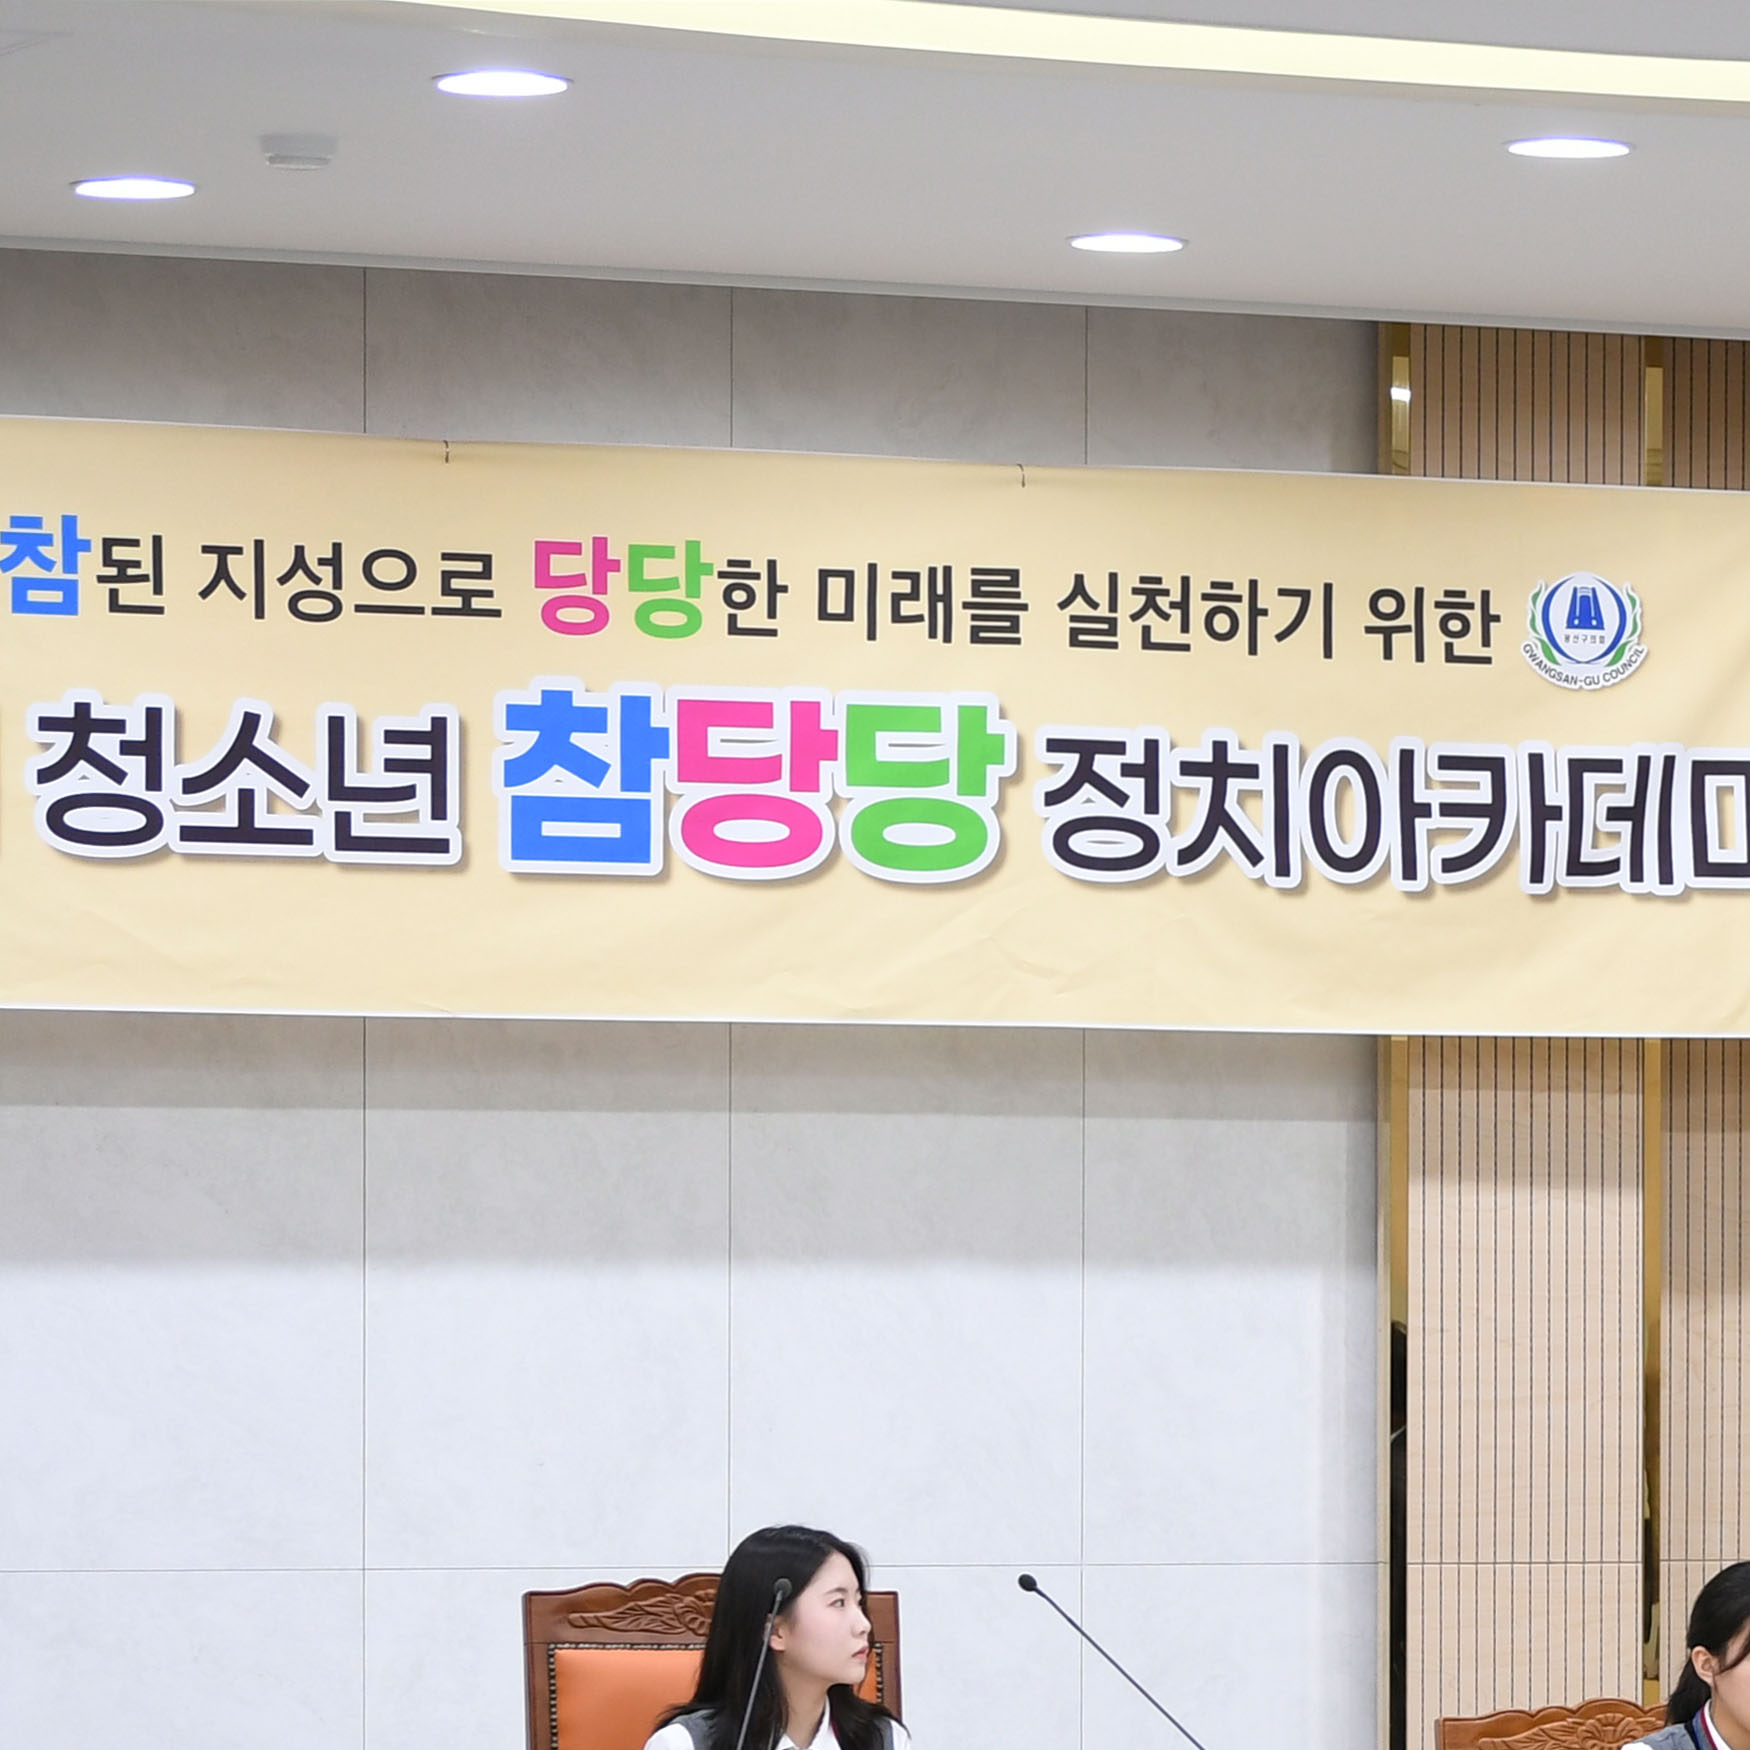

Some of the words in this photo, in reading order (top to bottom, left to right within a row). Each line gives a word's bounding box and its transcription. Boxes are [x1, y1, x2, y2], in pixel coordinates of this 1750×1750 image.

[0, 514, 165, 616] 참된
[198, 538, 502, 623] 지성으로
[534, 536, 789, 639] 당당한
[817, 562, 1029, 646] 미래를
[1057, 571, 1334, 660] 실천하기
[1363, 586, 1501, 665] 위한
[1522, 643, 1601, 687] GWANGSAN-GU
[1602, 647, 1645, 682] COUNCIL
[36, 701, 451, 854] 청소년
[503, 689, 1004, 871] 참당당
